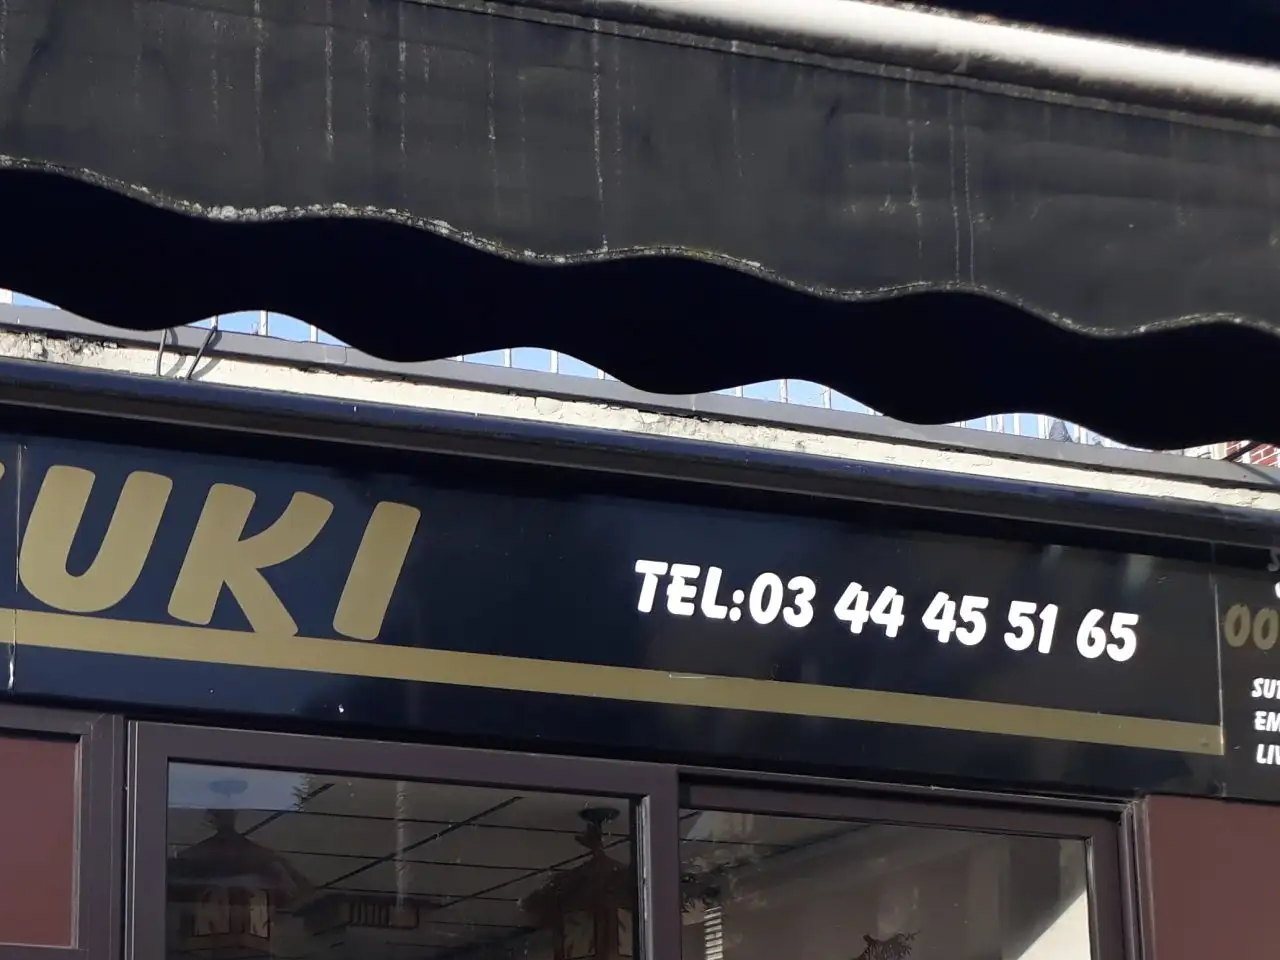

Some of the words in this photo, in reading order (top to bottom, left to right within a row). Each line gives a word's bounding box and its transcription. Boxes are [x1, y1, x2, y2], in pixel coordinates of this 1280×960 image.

[833, 581, 905, 638] 44
[922, 591, 990, 646] 45
[1003, 601, 1059, 654] 51
[1076, 608, 1140, 662] 65
